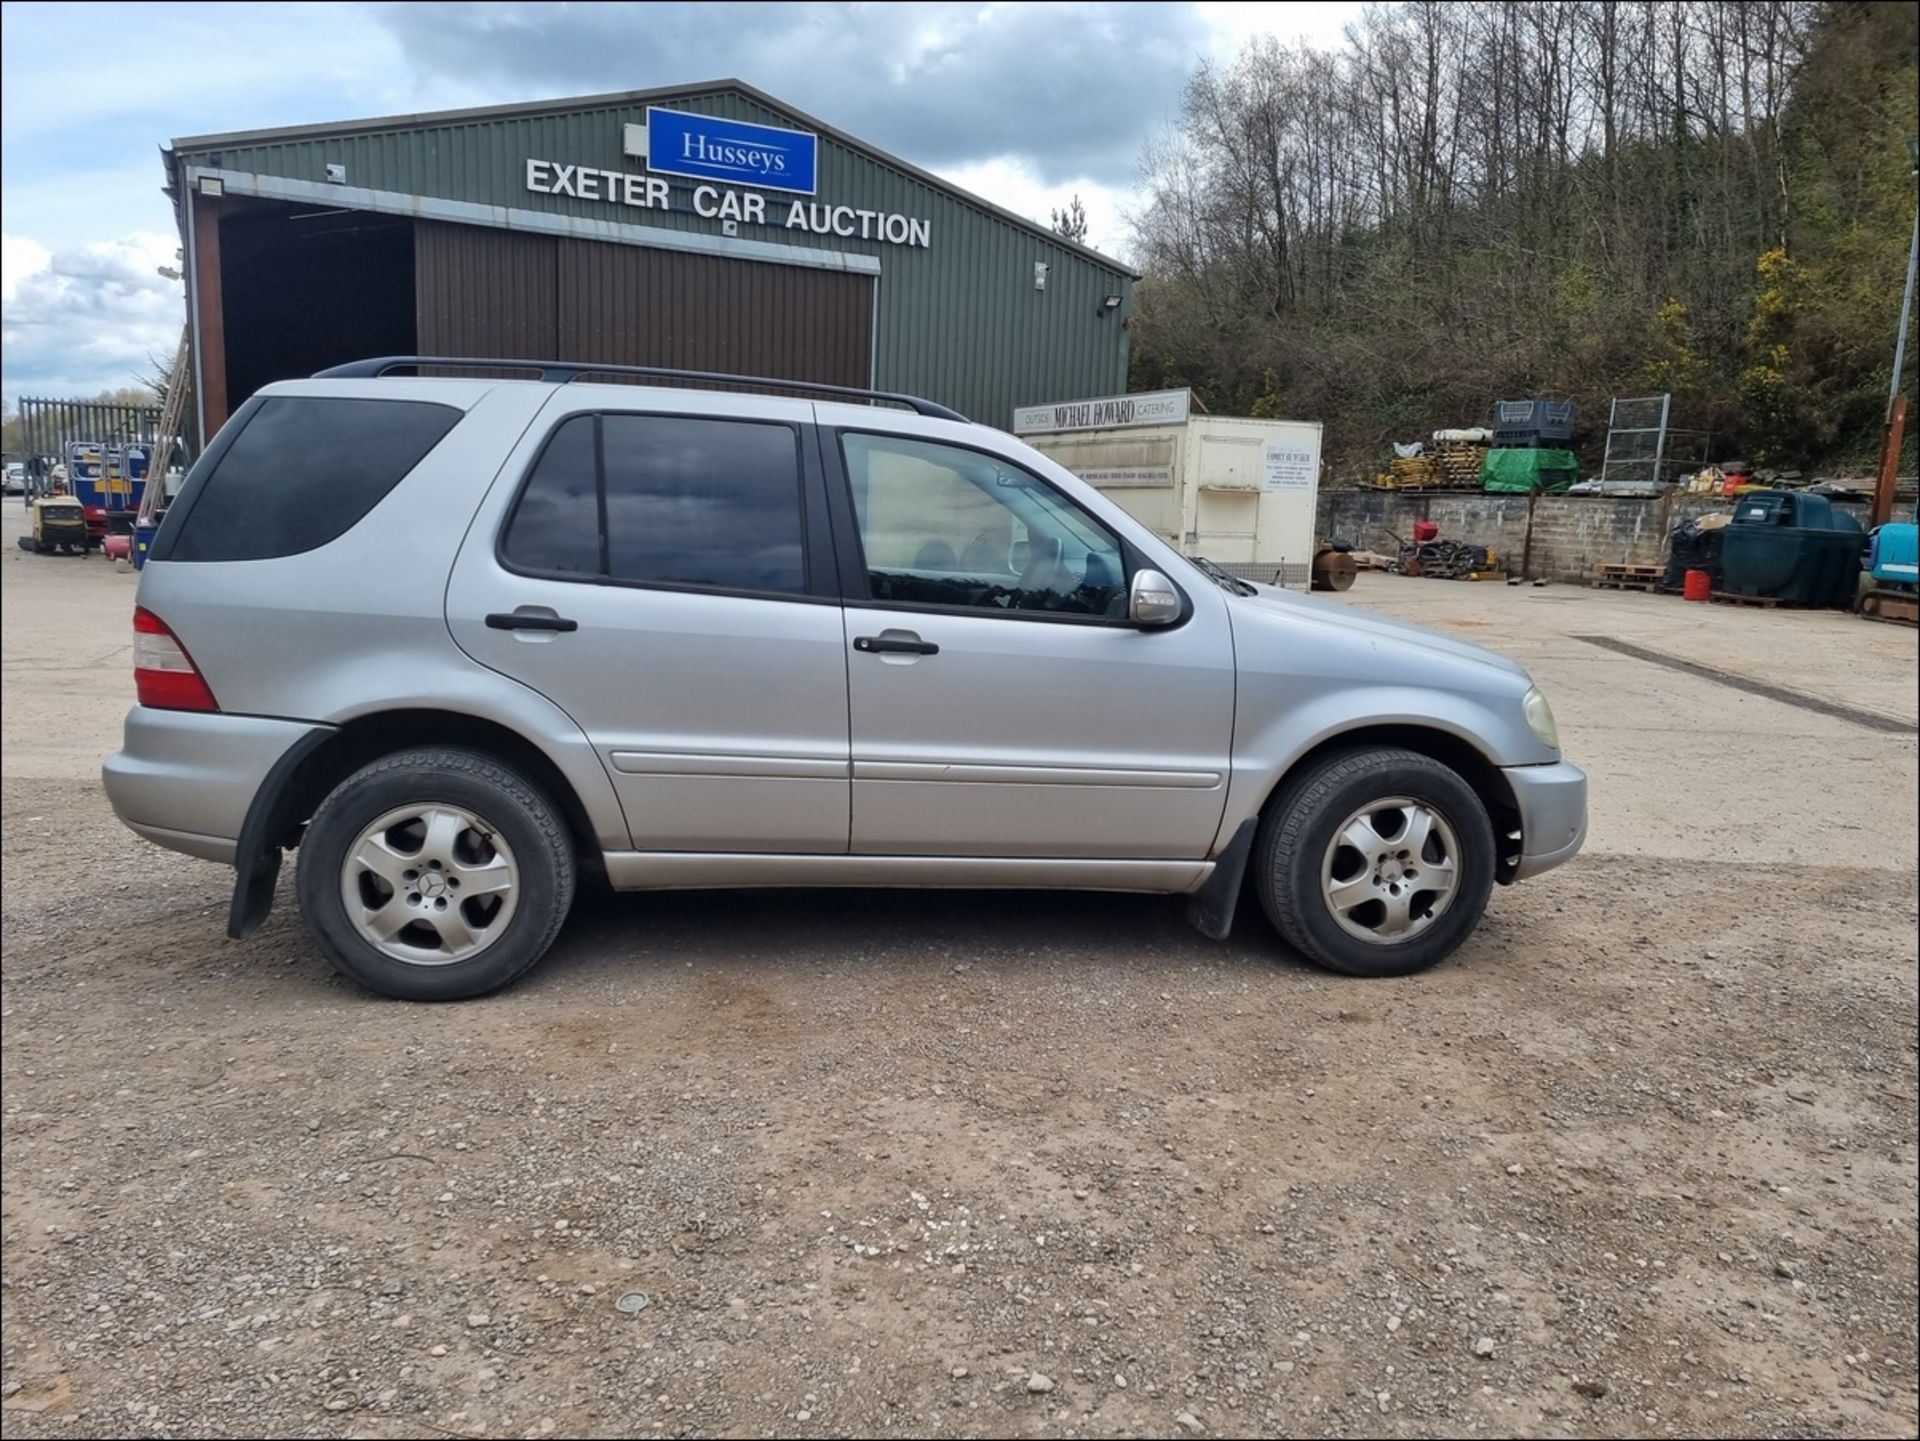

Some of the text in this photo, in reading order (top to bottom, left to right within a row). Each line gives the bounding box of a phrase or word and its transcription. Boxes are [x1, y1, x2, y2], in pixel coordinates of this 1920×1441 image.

[682, 132, 785, 175] Husseys
[526, 159, 930, 248] EXETER CAR AUCTION
[1024, 400, 1175, 428] OUTSIDE MICHAEL HOWARD CATERING
